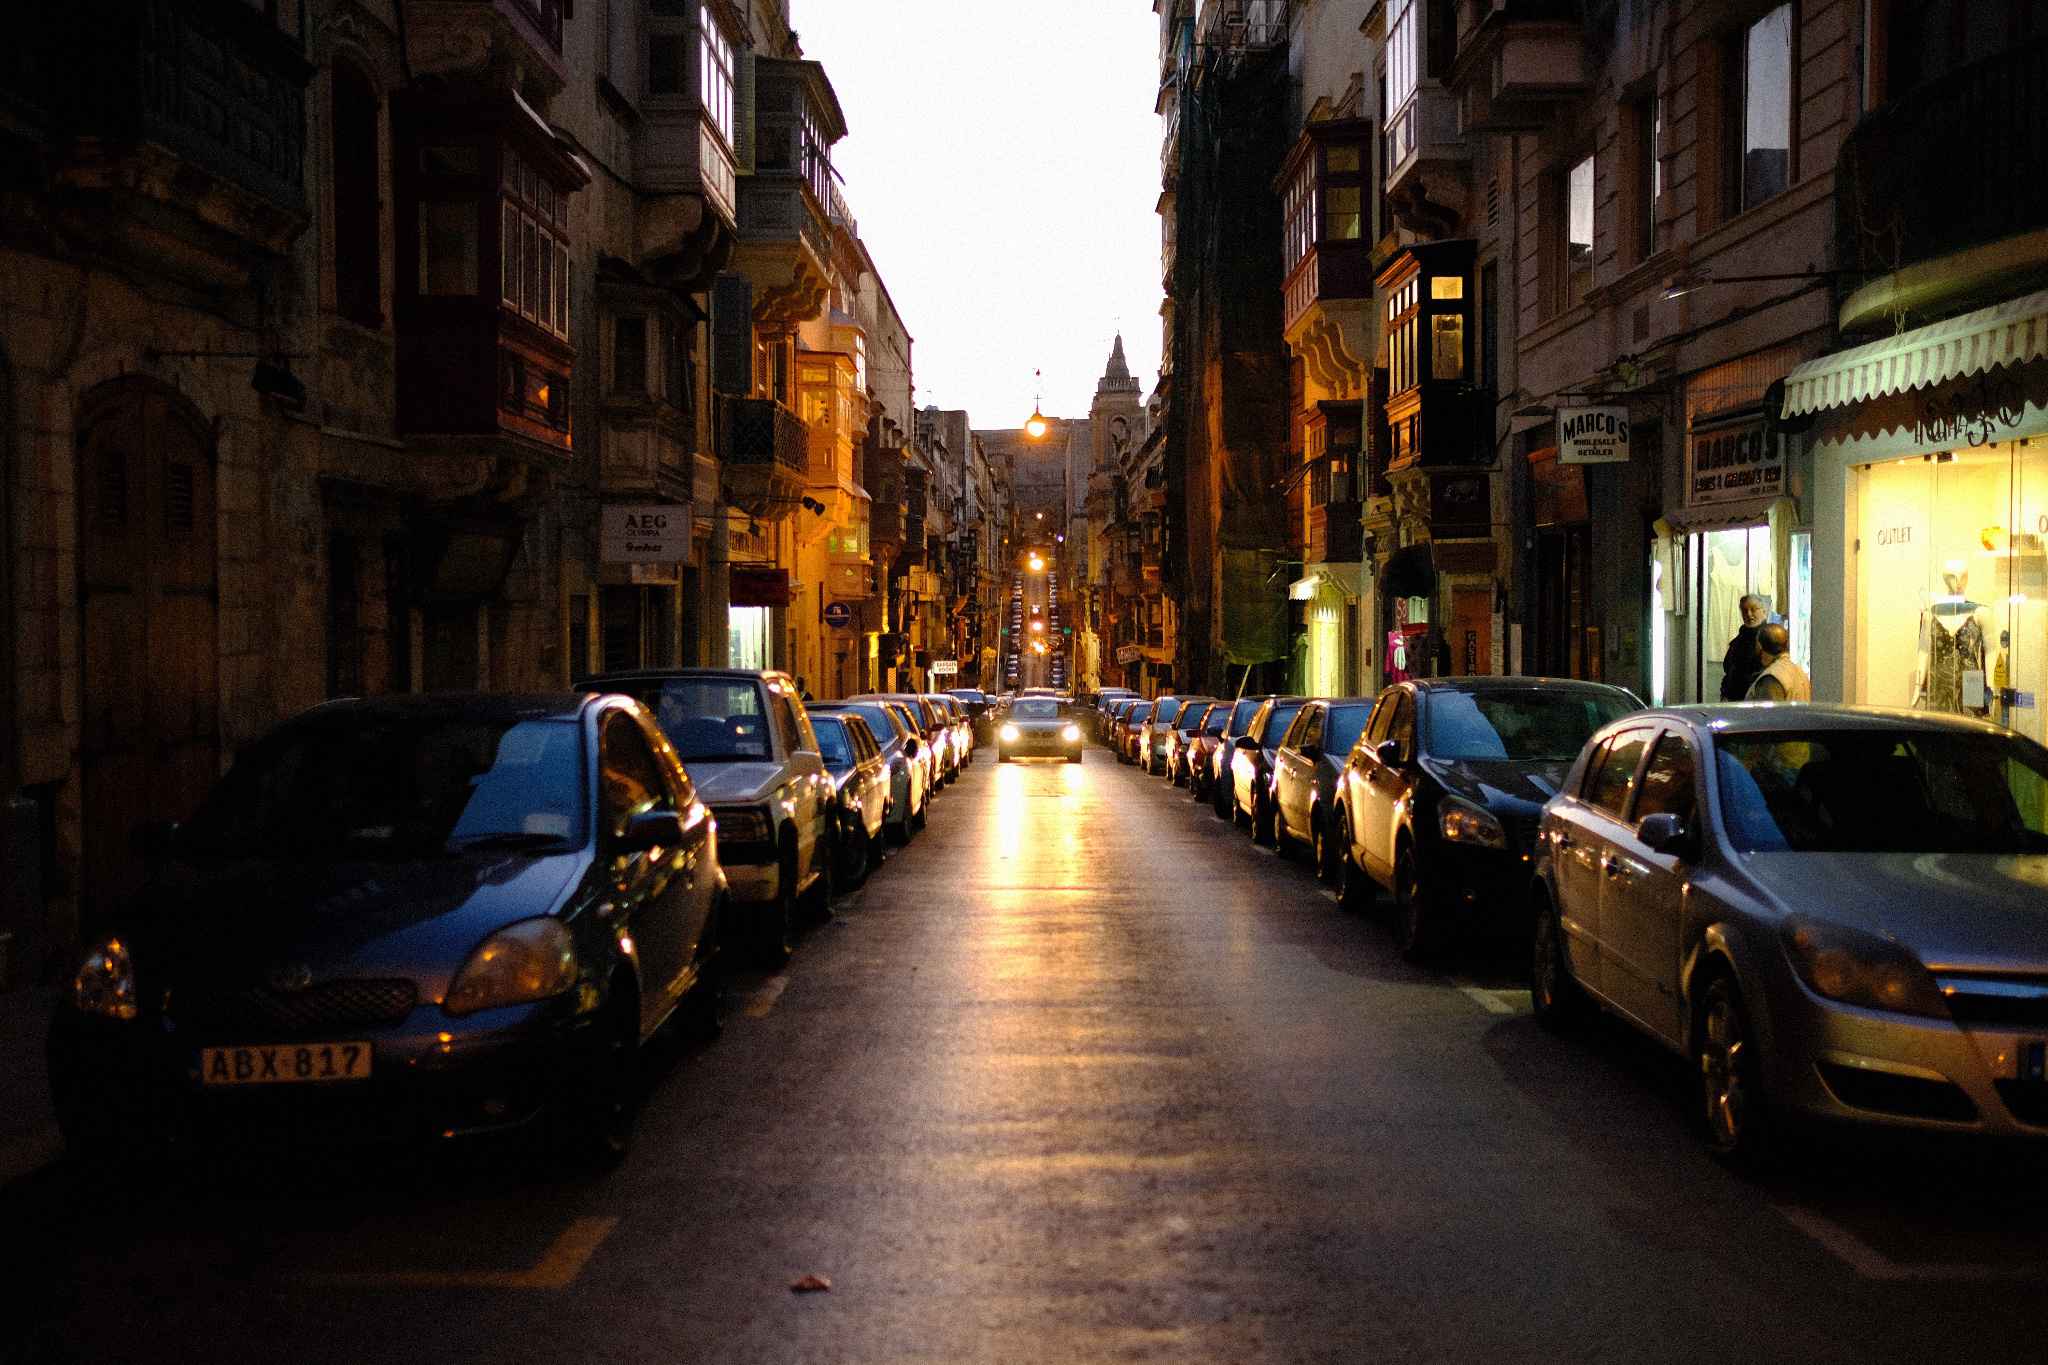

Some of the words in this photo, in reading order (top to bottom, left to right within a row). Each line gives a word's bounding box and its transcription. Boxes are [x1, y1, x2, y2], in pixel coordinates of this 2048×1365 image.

[1563, 412, 1628, 445] MARCO'S
[625, 514, 667, 529] AEG
[1877, 527, 1912, 546] OUTLET
[211, 1049, 277, 1079] ABX
[295, 1046, 359, 1076] 817
